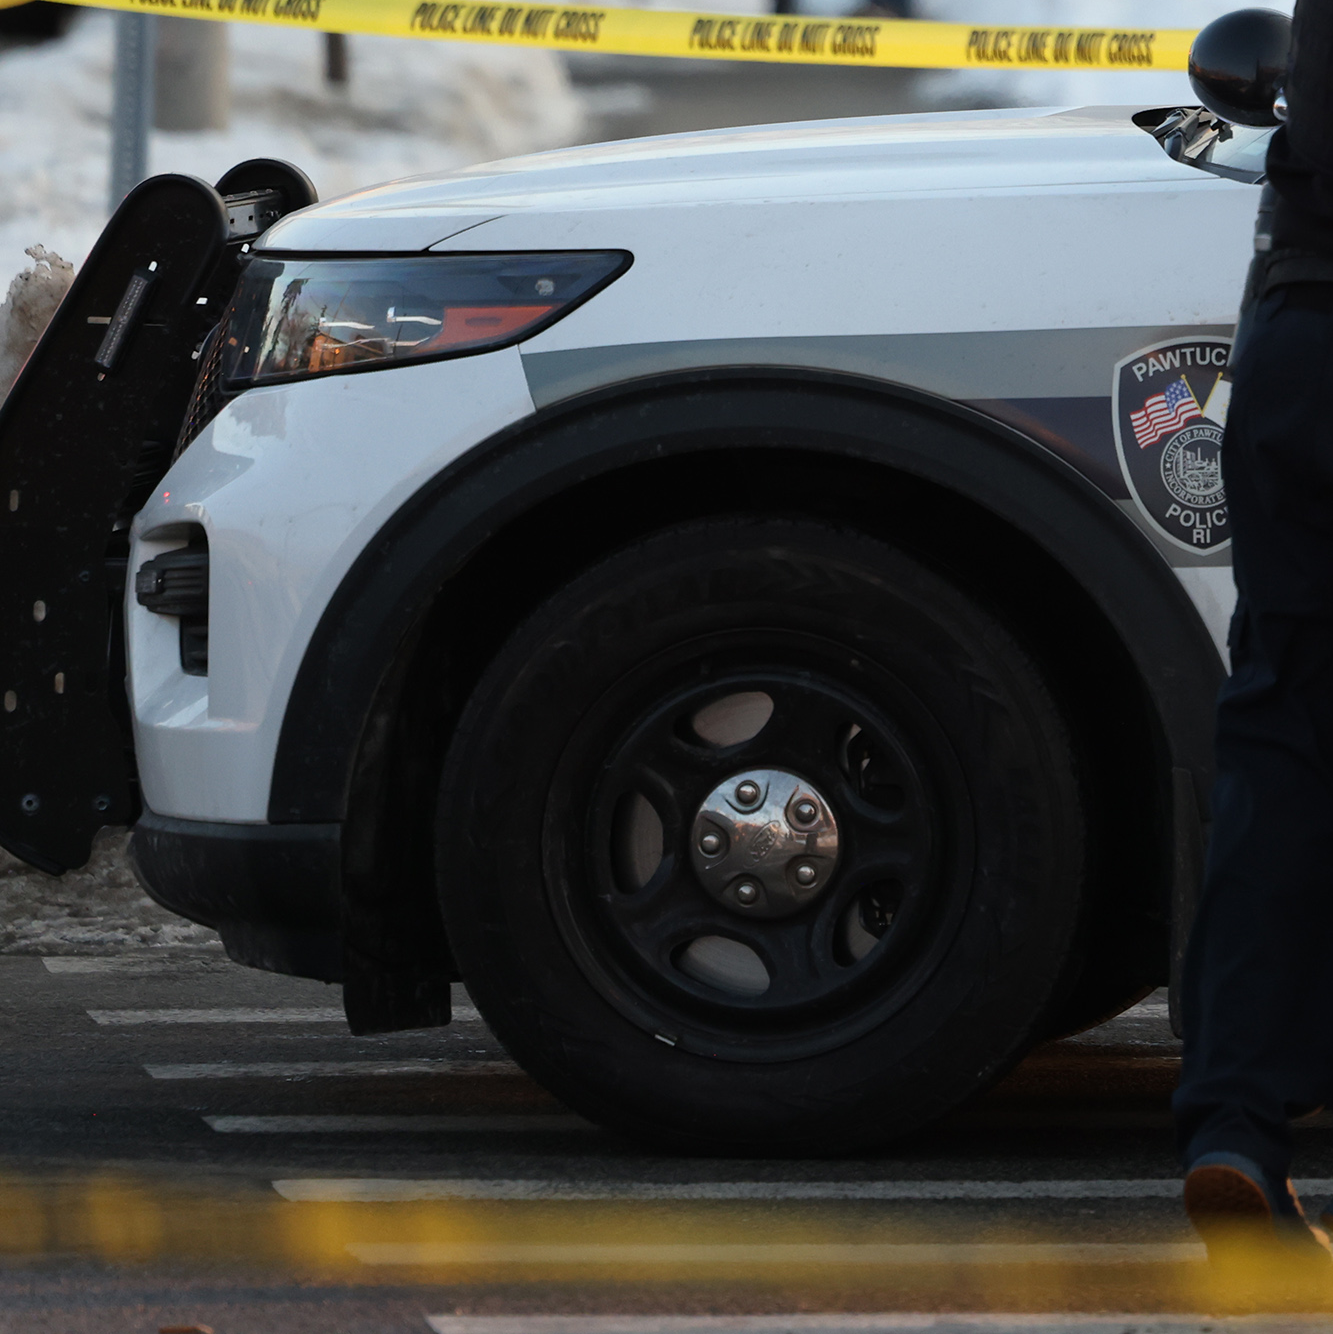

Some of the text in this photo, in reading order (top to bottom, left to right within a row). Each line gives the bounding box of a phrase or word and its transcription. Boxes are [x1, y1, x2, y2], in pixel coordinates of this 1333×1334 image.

[1132, 347, 1227, 383] PAWTUC
[1194, 429, 1223, 442] PAWTU
[1165, 503, 1228, 529] POLIC
[1192, 528, 1211, 544] RI
